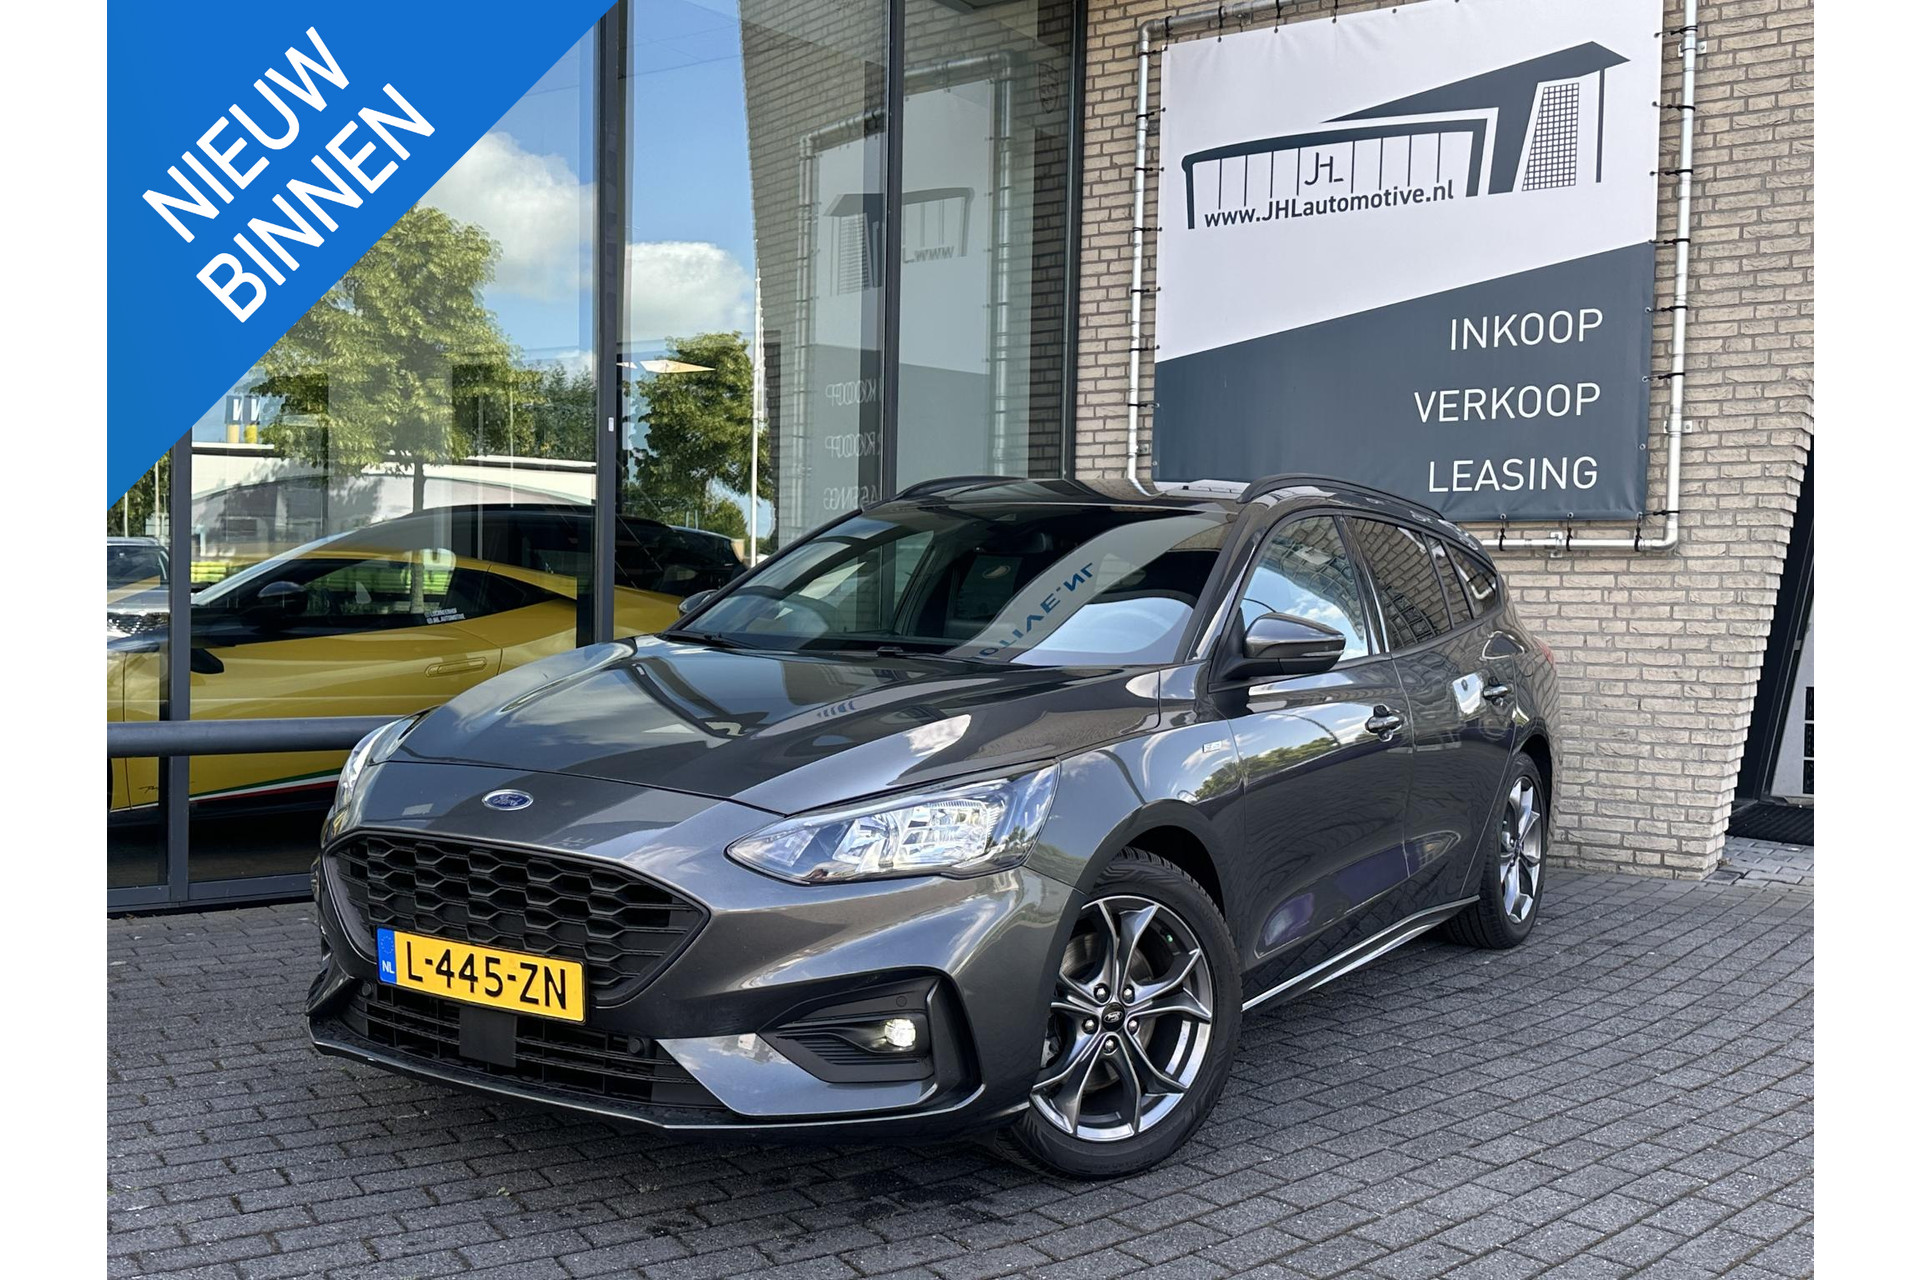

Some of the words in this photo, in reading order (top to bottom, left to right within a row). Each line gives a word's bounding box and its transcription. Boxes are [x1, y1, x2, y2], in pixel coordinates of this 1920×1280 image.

[1204, 180, 1455, 228] www.JHLautomotive.nl
[1451, 308, 1604, 351] INKOOP
[1414, 382, 1601, 424] VERKOOP
[1428, 456, 1598, 493] LEASING
[382, 959, 395, 974] NL
[406, 941, 567, 1010] L-445-ZN
